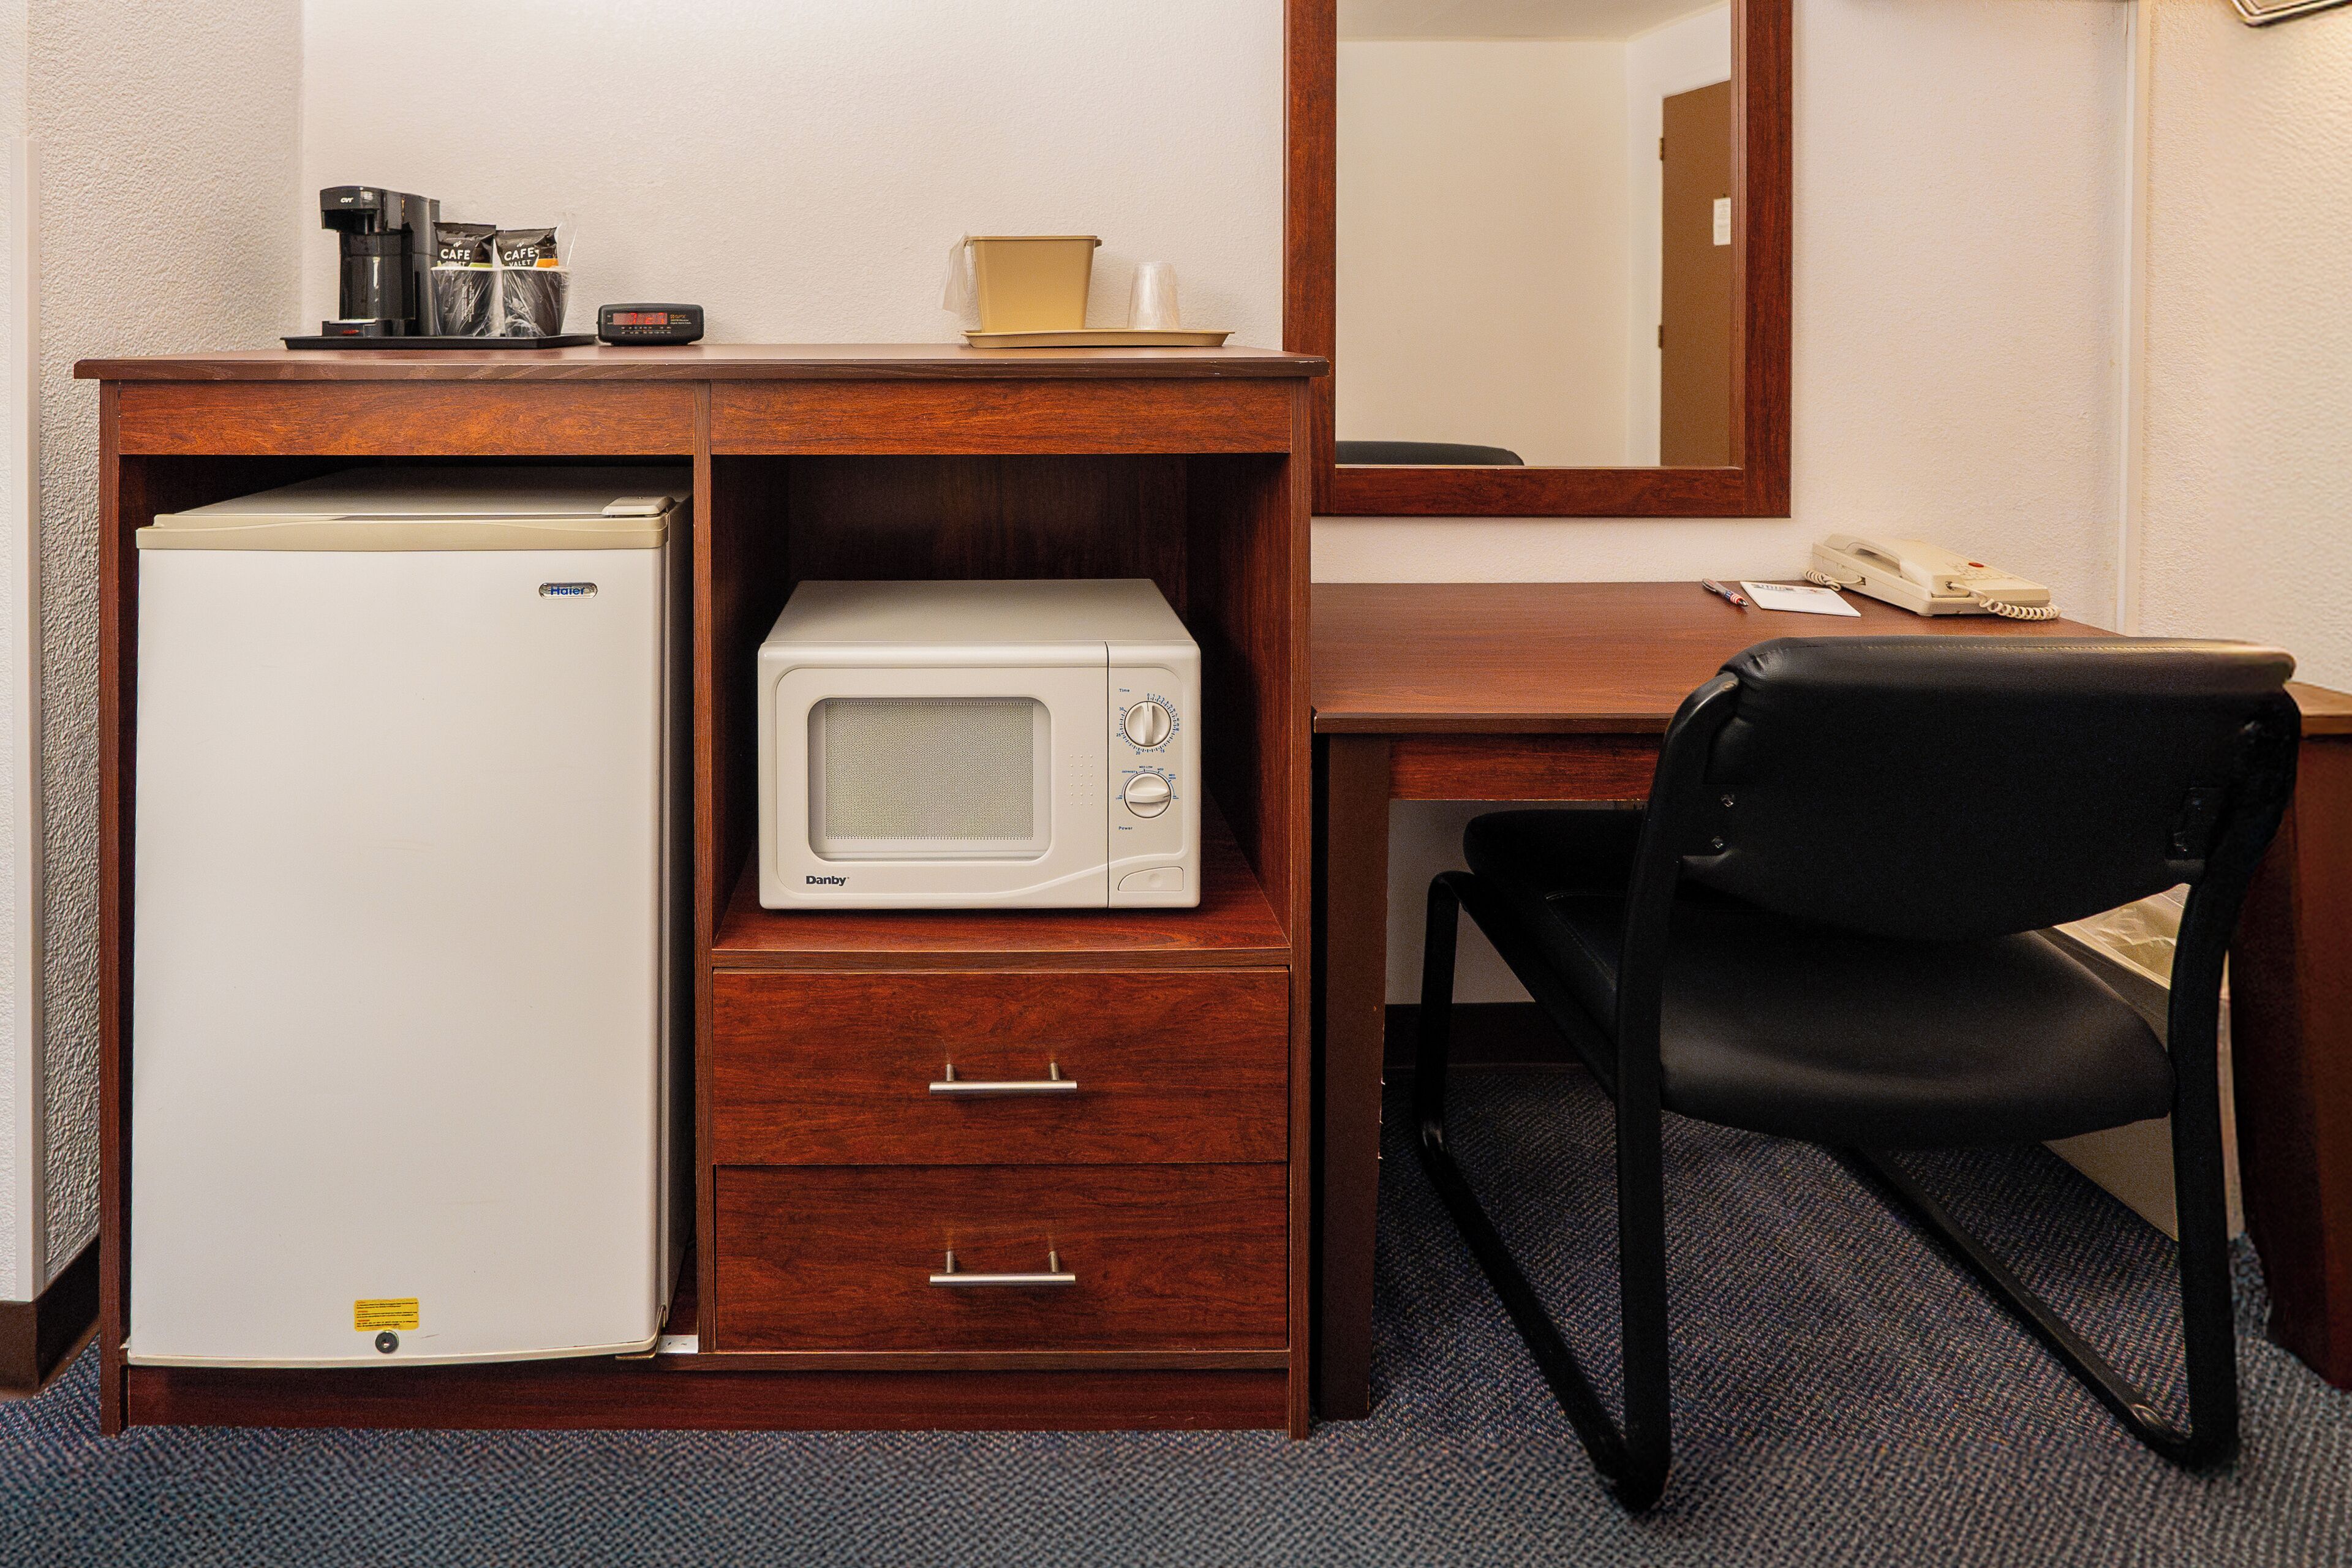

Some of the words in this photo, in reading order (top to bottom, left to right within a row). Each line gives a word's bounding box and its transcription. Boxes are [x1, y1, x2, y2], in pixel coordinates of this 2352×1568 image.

[440, 249, 470, 260] CAFE
[504, 247, 535, 261] CAFE
[550, 585, 585, 595] Haier
[806, 876, 846, 886] Danby
